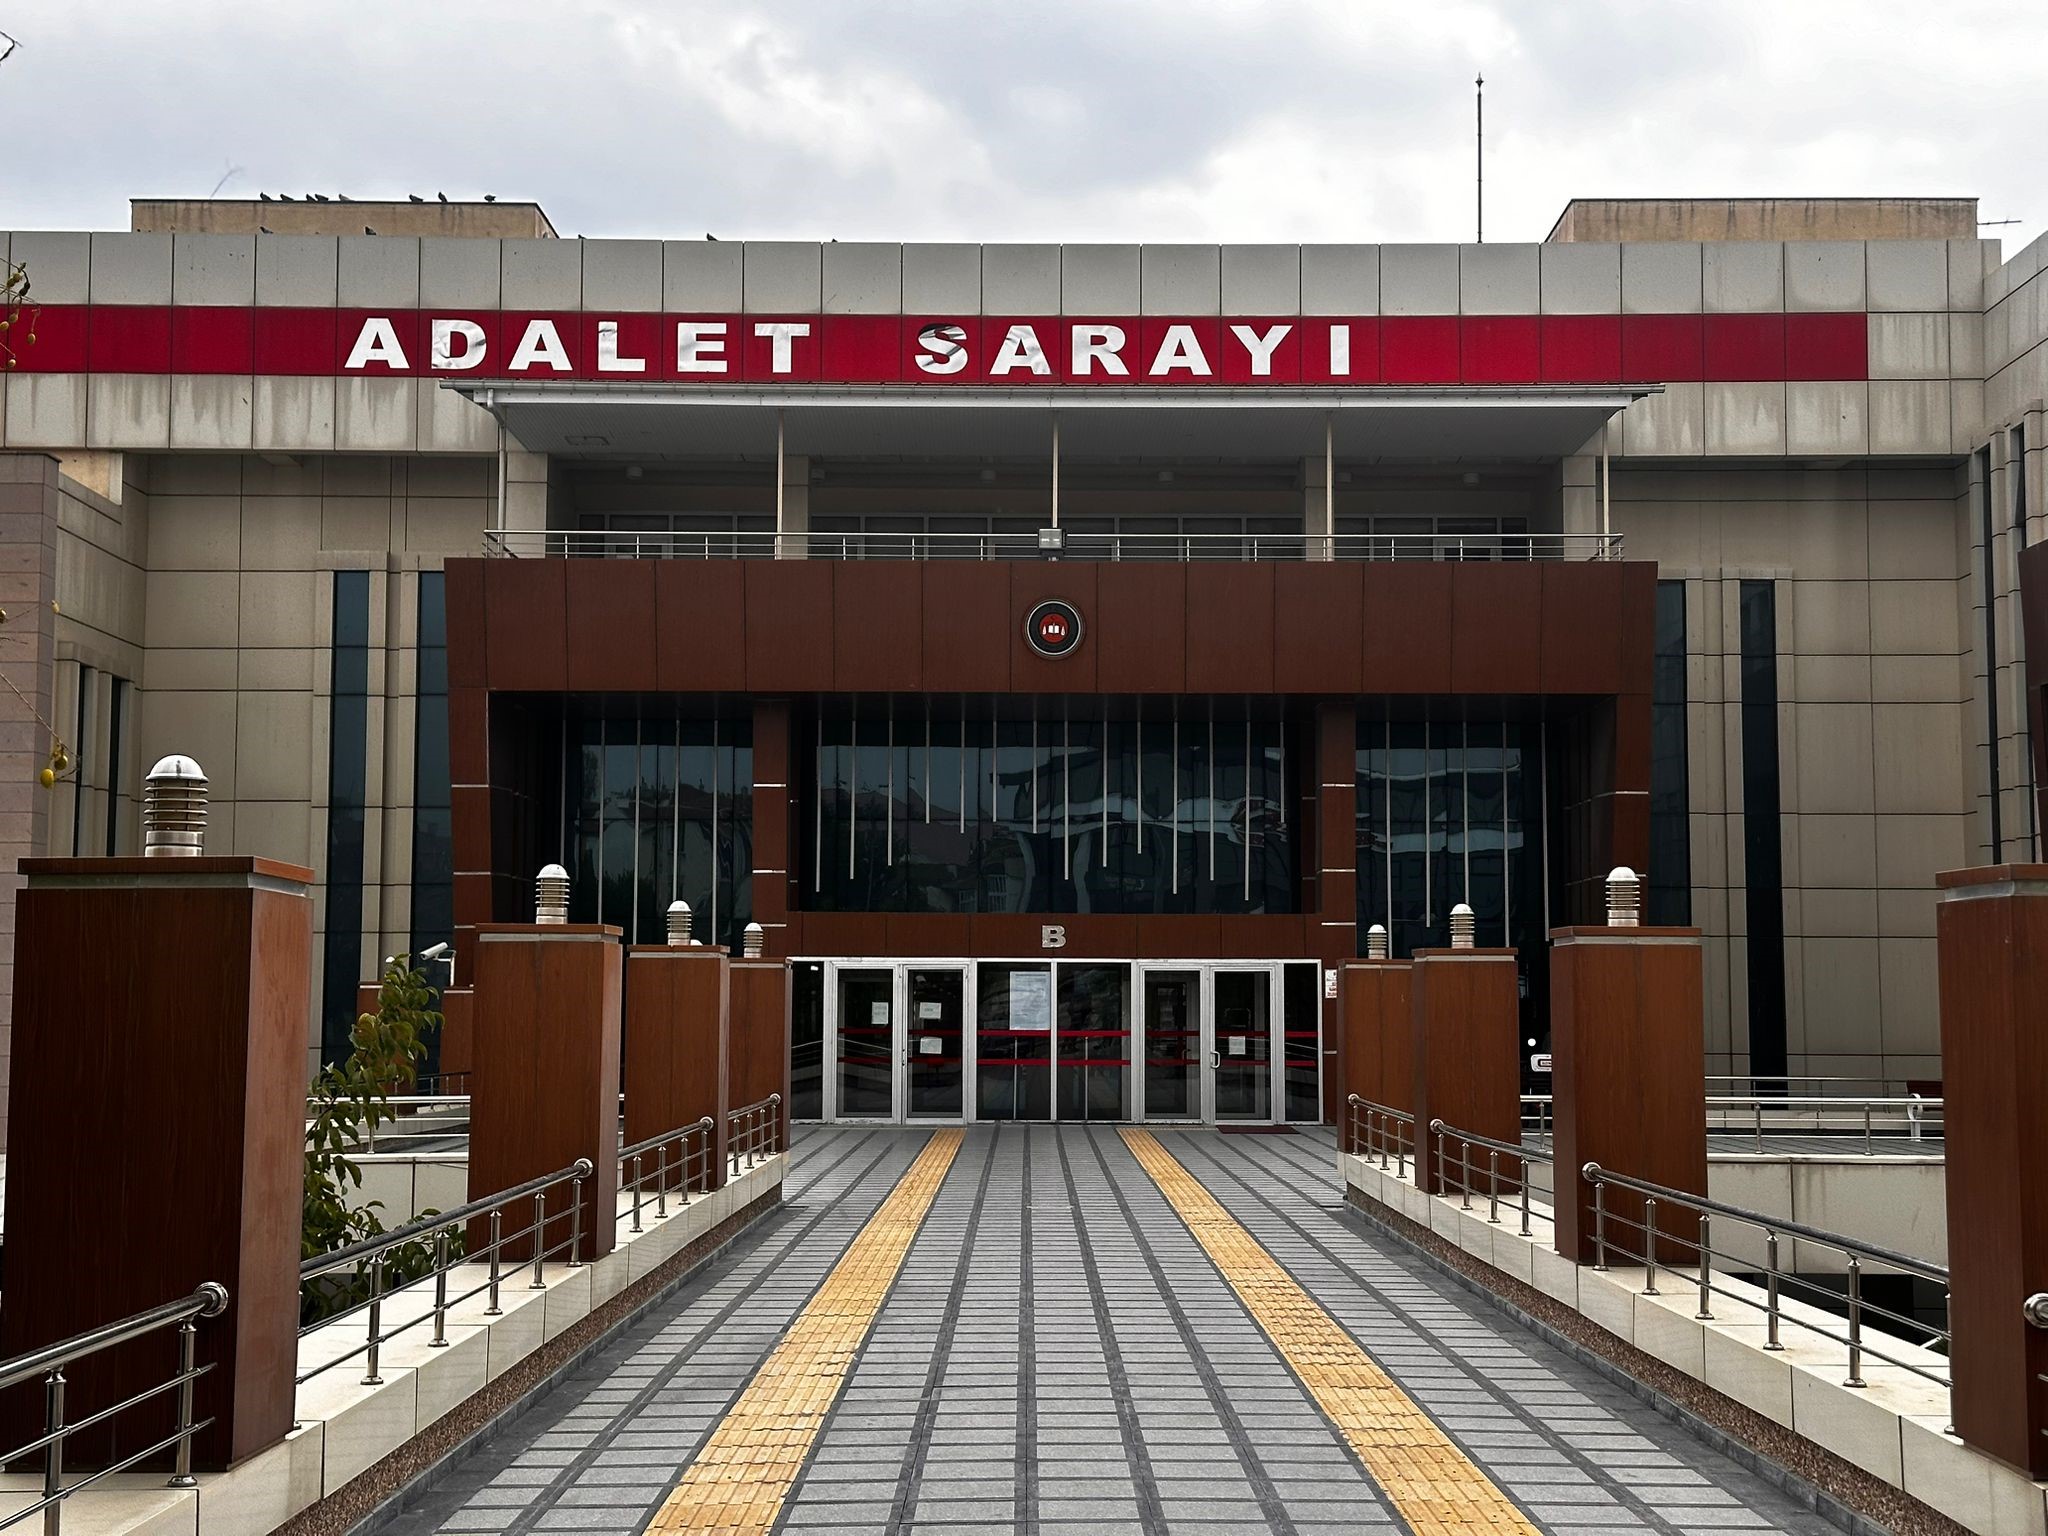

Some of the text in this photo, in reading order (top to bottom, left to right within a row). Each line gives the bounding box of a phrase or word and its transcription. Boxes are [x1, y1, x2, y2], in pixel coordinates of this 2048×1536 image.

[345, 317, 1350, 377] ADALET SARAYI
[1041, 925, 1067, 948] B
